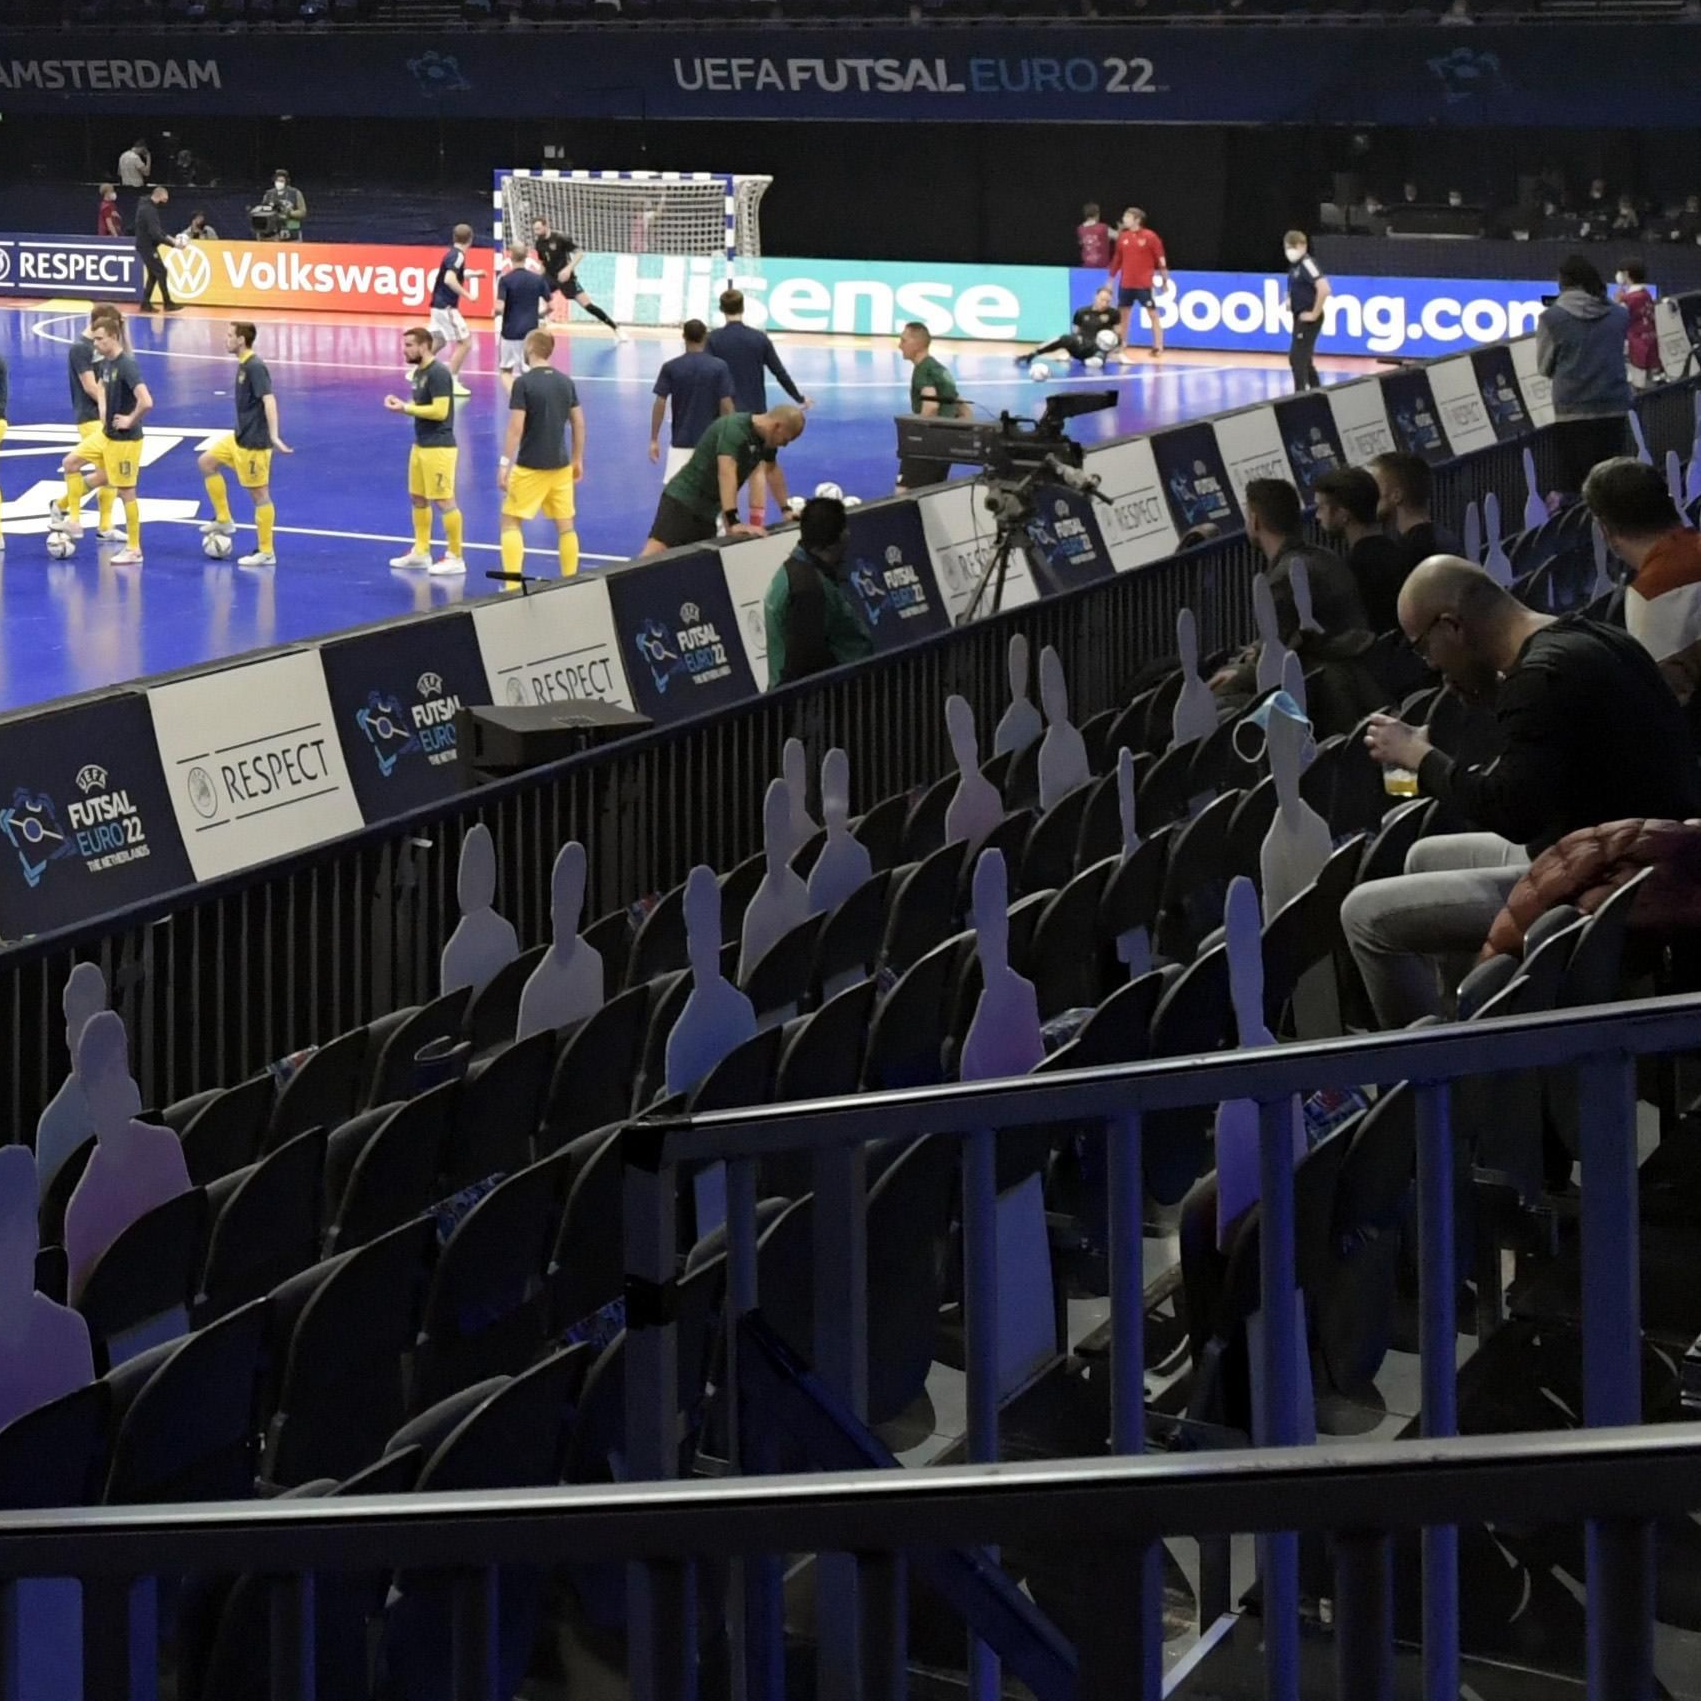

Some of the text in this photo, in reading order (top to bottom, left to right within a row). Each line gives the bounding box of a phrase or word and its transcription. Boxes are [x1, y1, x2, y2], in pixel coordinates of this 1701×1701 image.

[674, 57, 786, 92] UEFA
[787, 57, 966, 92] FUTSAL
[969, 57, 1099, 93] EURO
[19, 252, 135, 282] RESPECT
[224, 251, 479, 306] Volkswag
[615, 253, 1020, 339] Hisense
[221, 739, 328, 803] RESPECT
[68, 790, 137, 829] FUTSAL
[76, 816, 145, 856] EURO 22
